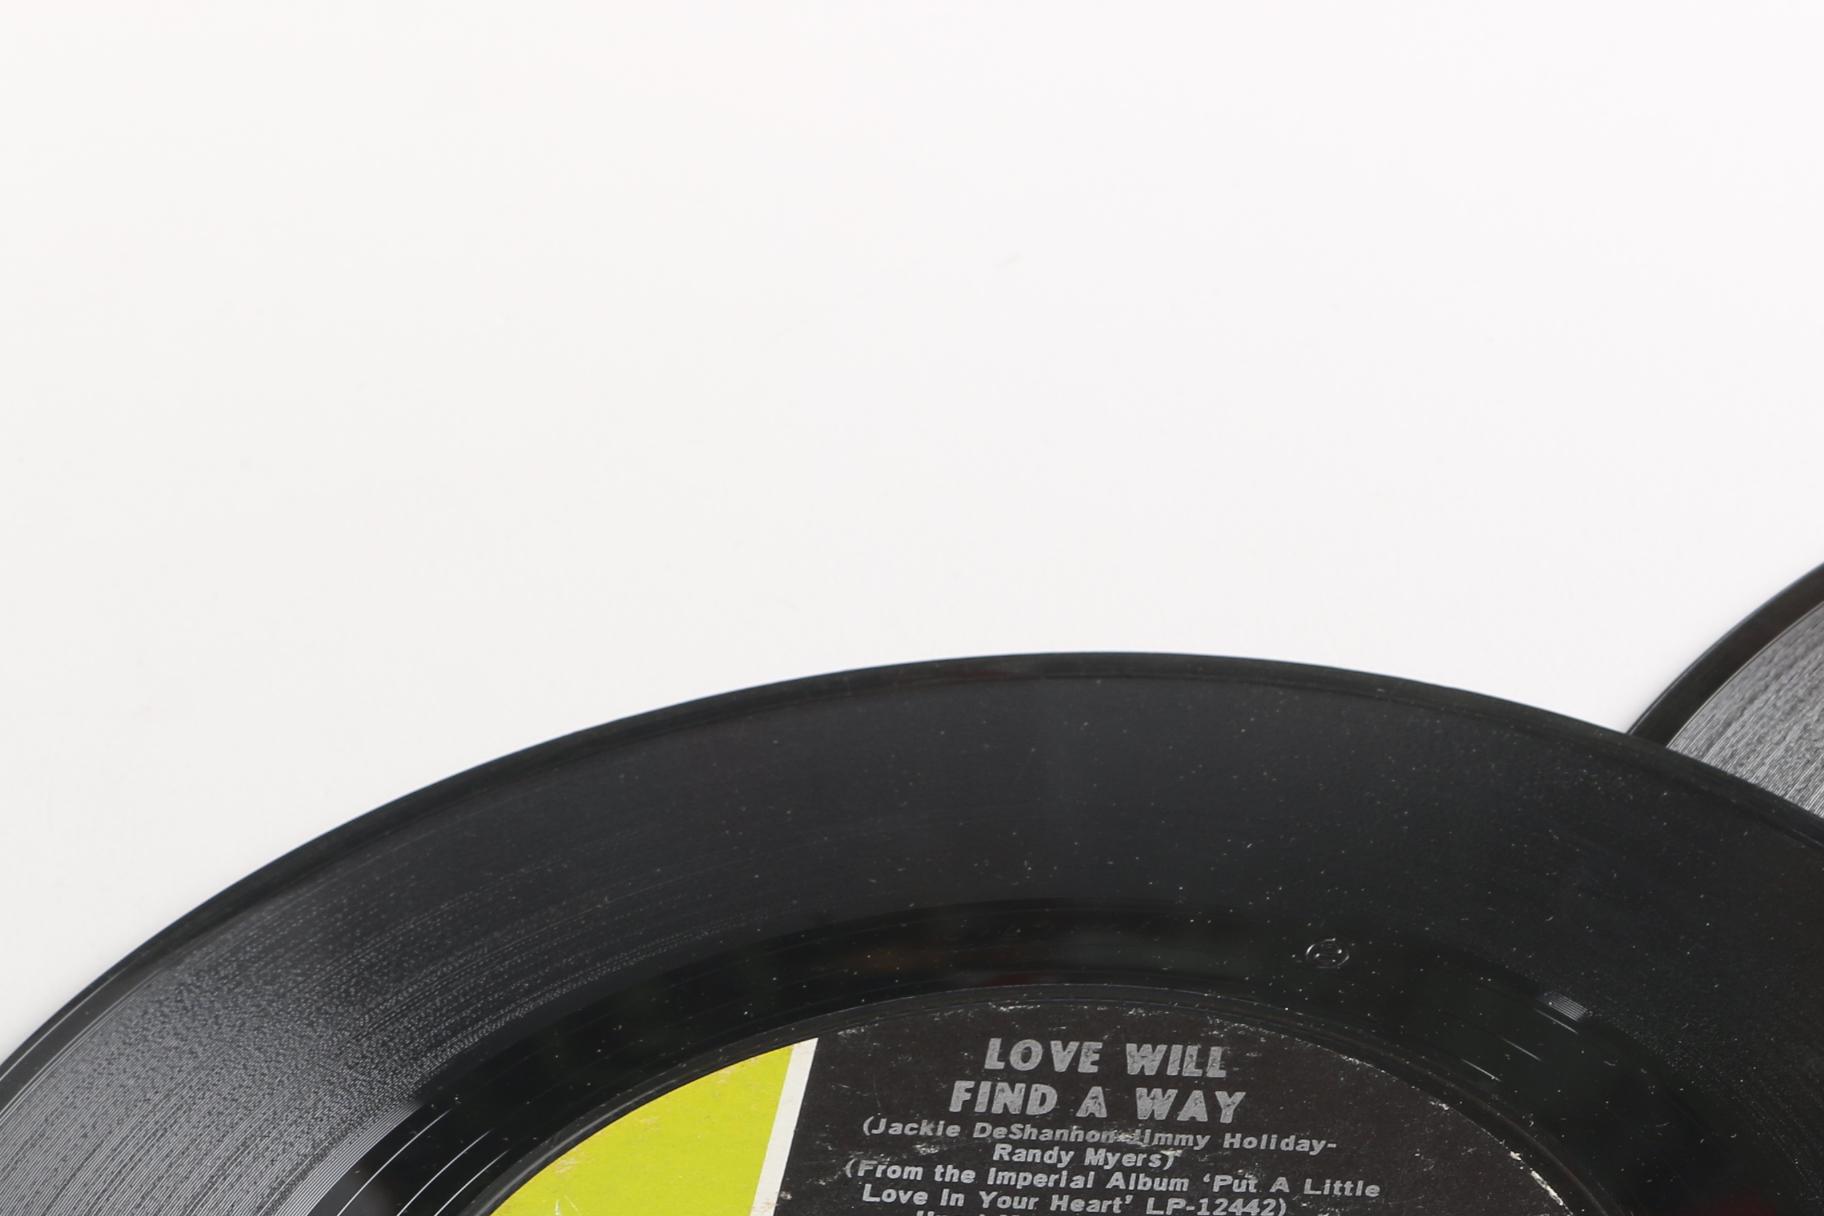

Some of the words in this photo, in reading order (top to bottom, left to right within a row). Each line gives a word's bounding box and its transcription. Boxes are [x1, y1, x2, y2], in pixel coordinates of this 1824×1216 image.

[984, 1037, 1103, 1075] LOVE
[1125, 1043, 1229, 1079] WILL
[948, 1080, 1058, 1117] FIND
[1075, 1088, 1108, 1119] A
[1134, 1088, 1247, 1125] WAY
[862, 1116, 960, 1140] (Jackie
[1223, 1132, 1338, 1156] Holiday-
[843, 1157, 924, 1181] (From
[934, 1165, 976, 1184] the
[987, 1167, 1095, 1190] Imperial
[1105, 1172, 1190, 1194] Album
[1270, 1175, 1291, 1194] A
[1303, 1178, 1381, 1199] Little
[992, 1144, 1075, 1168] Randy
[1084, 1148, 1178, 1171] Myers)
[861, 1183, 929, 1206] Love
[940, 1188, 966, 1208] In
[978, 1191, 1042, 1212] Your
